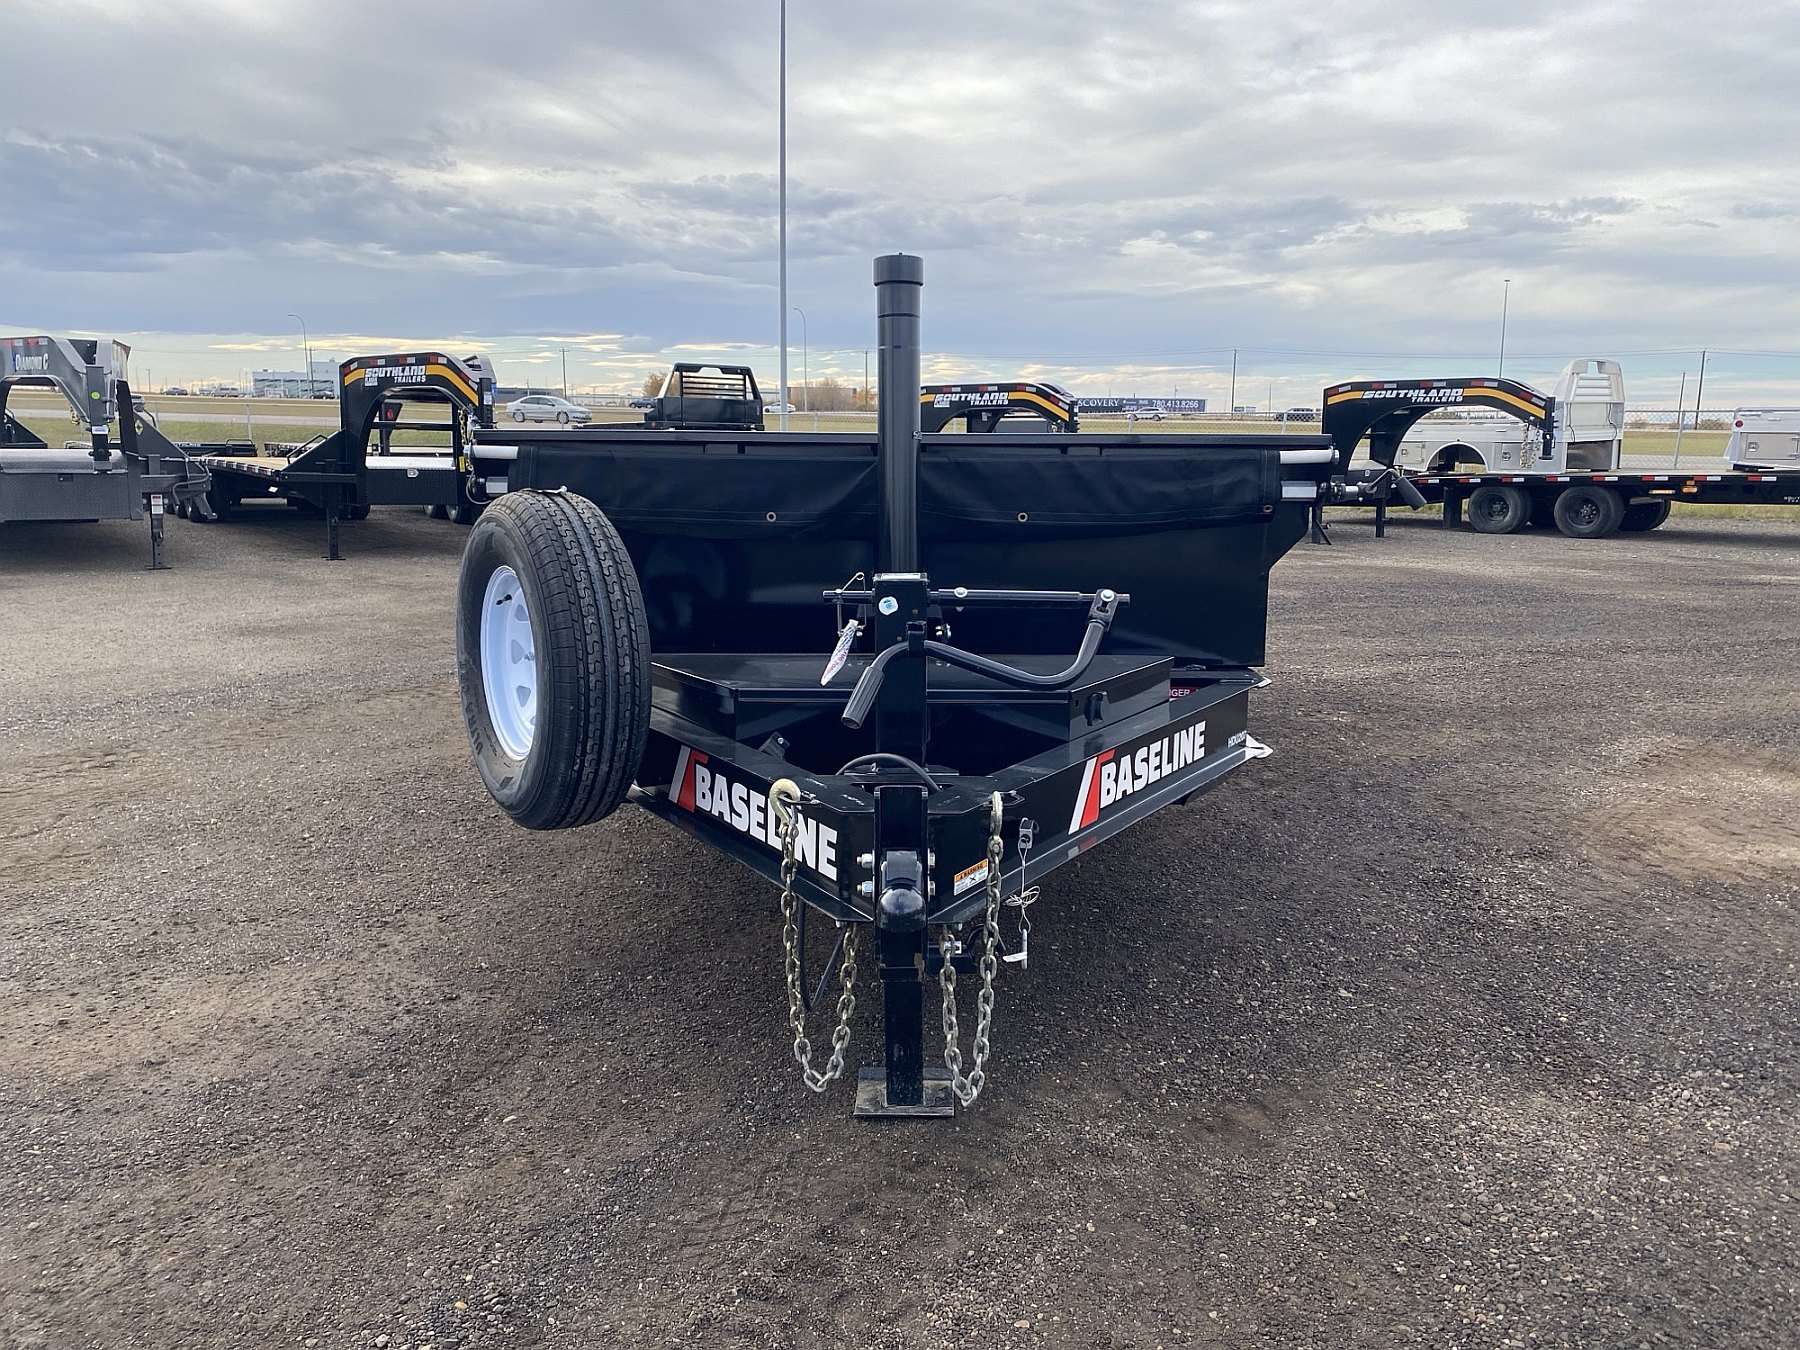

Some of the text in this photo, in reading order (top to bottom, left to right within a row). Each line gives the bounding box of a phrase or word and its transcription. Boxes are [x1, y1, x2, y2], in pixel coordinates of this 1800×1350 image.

[364, 365, 426, 378] SOUTHLAND
[934, 392, 1009, 403] SOUTHLAND
[1361, 388, 1464, 399] SOUTHLAND
[1100, 720, 1206, 809] BASELINE
[695, 763, 838, 882] BASELNE
